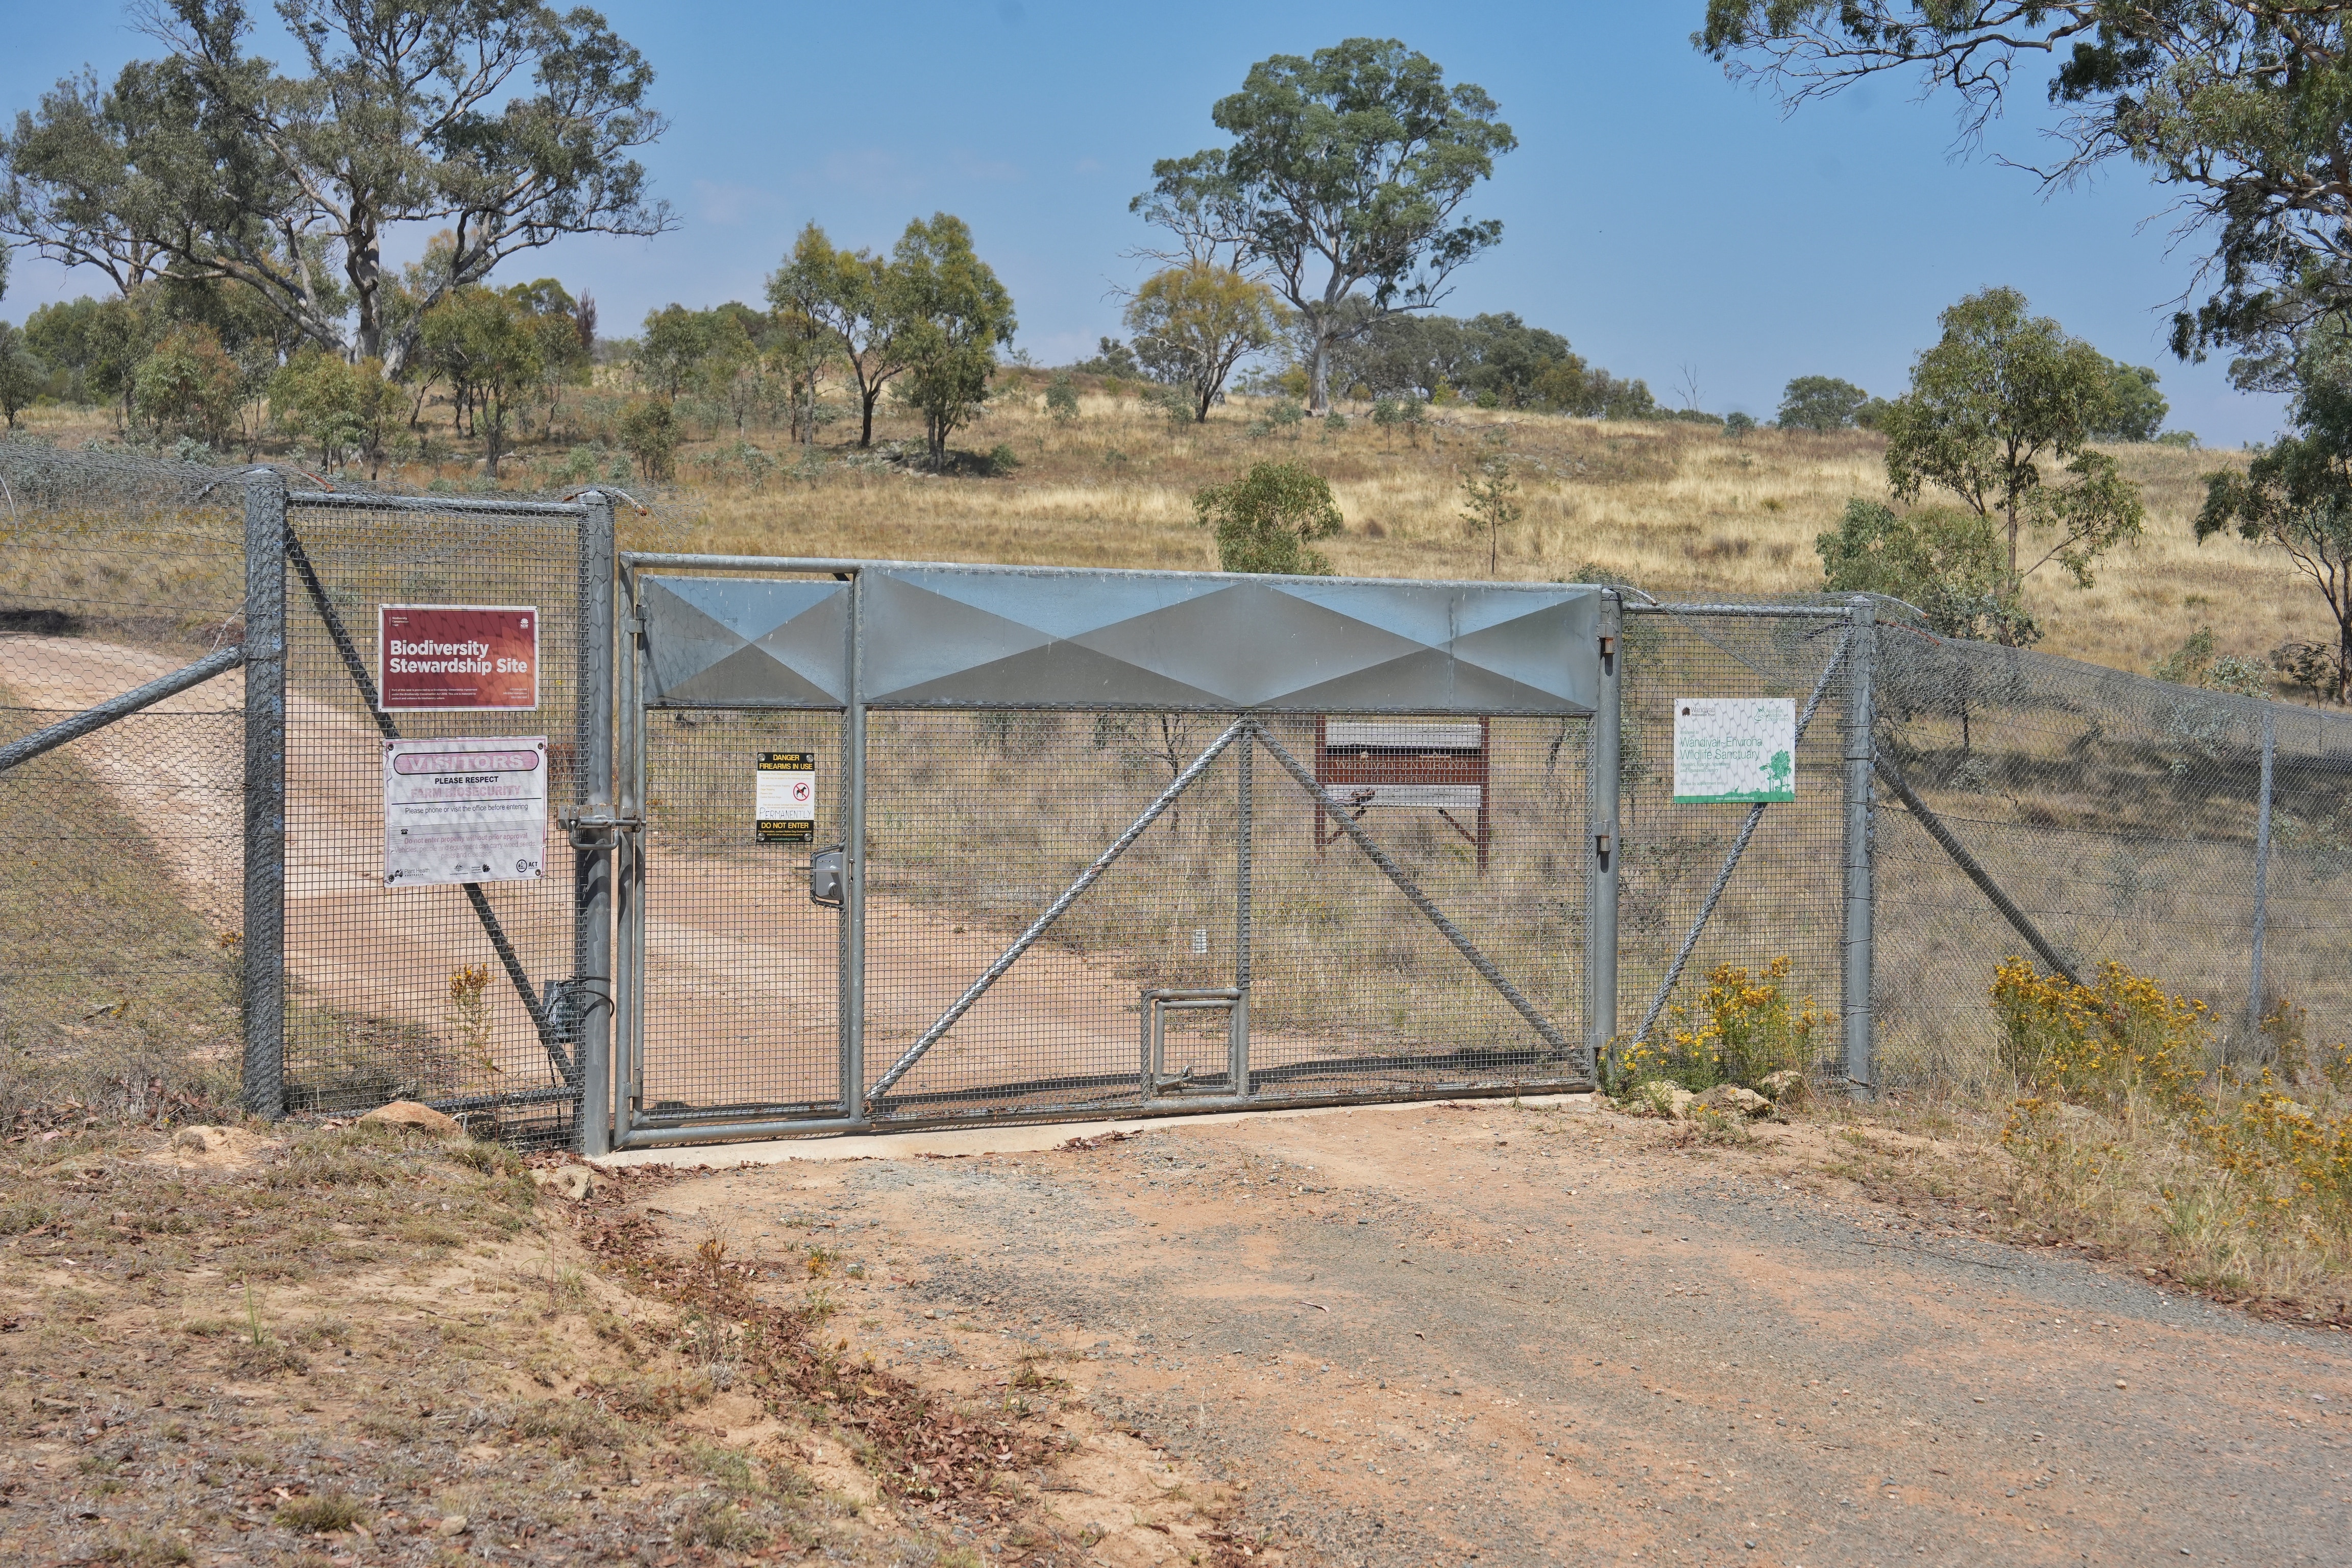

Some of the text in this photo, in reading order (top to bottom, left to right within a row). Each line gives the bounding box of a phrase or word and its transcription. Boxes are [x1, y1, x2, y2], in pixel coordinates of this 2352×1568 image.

[390, 640, 489, 658] Biodiversity
[389, 657, 528, 676] Stewardship Site
[1680, 736, 1762, 749] Wandiyali~Environa
[1680, 749, 1760, 761] Wildlife Sanctuary
[409, 755, 524, 771] VISITORS
[411, 785, 521, 799] FARM BIOSECURITY
[759, 807, 812, 819] PERMANENTLY
